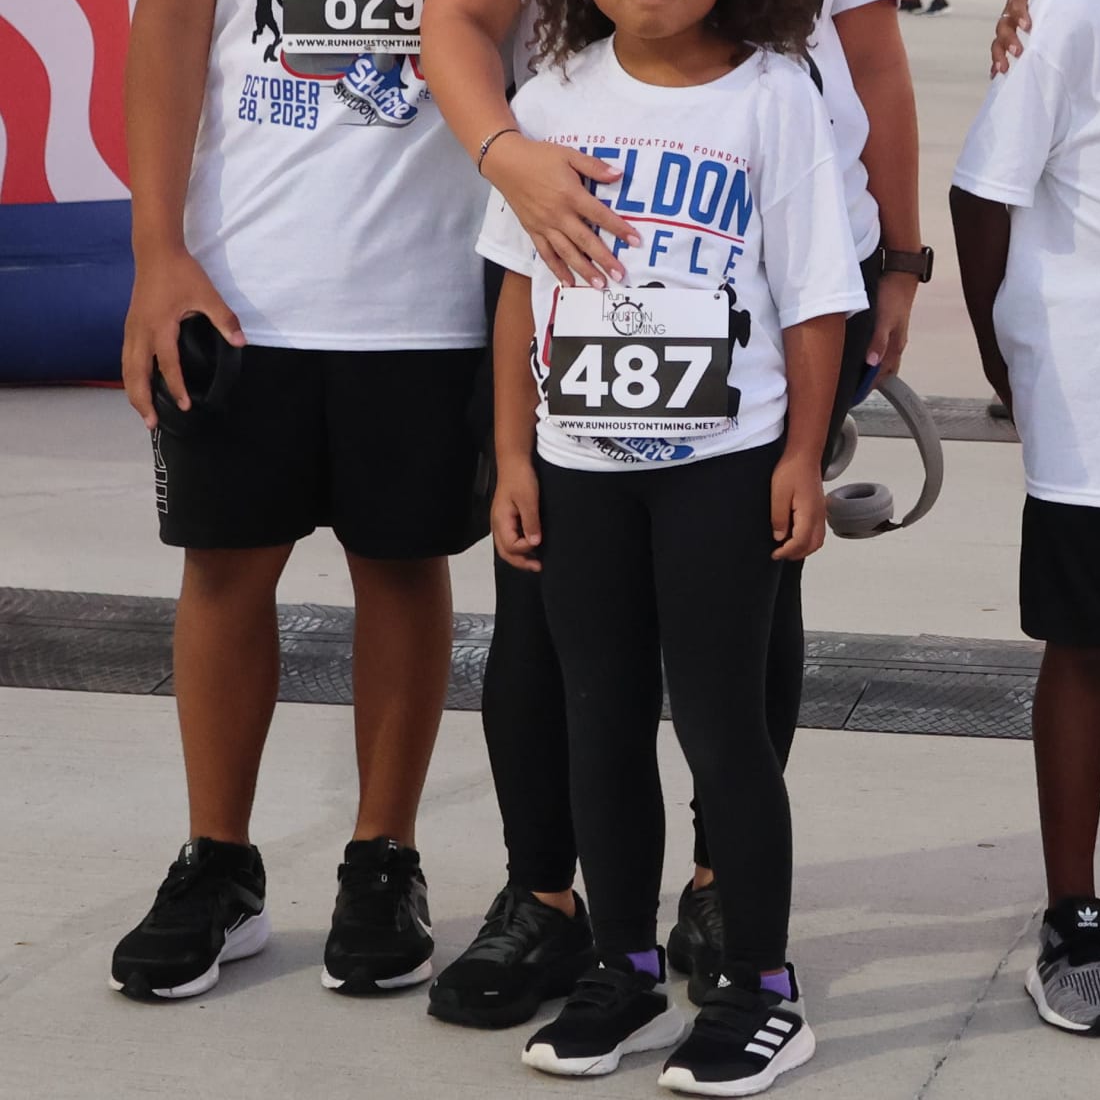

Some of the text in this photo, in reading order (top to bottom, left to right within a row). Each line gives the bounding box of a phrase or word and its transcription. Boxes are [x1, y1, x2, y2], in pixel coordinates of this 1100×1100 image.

[242, 74, 320, 106] OCTOBER
[238, 96, 319, 131] 28, 2023
[586, 134, 606, 144] ISD
[614, 136, 684, 151] EDUCATION
[579, 146, 753, 237] ELDON
[602, 311, 653, 322] HOUSTON
[559, 343, 713, 410] 487
